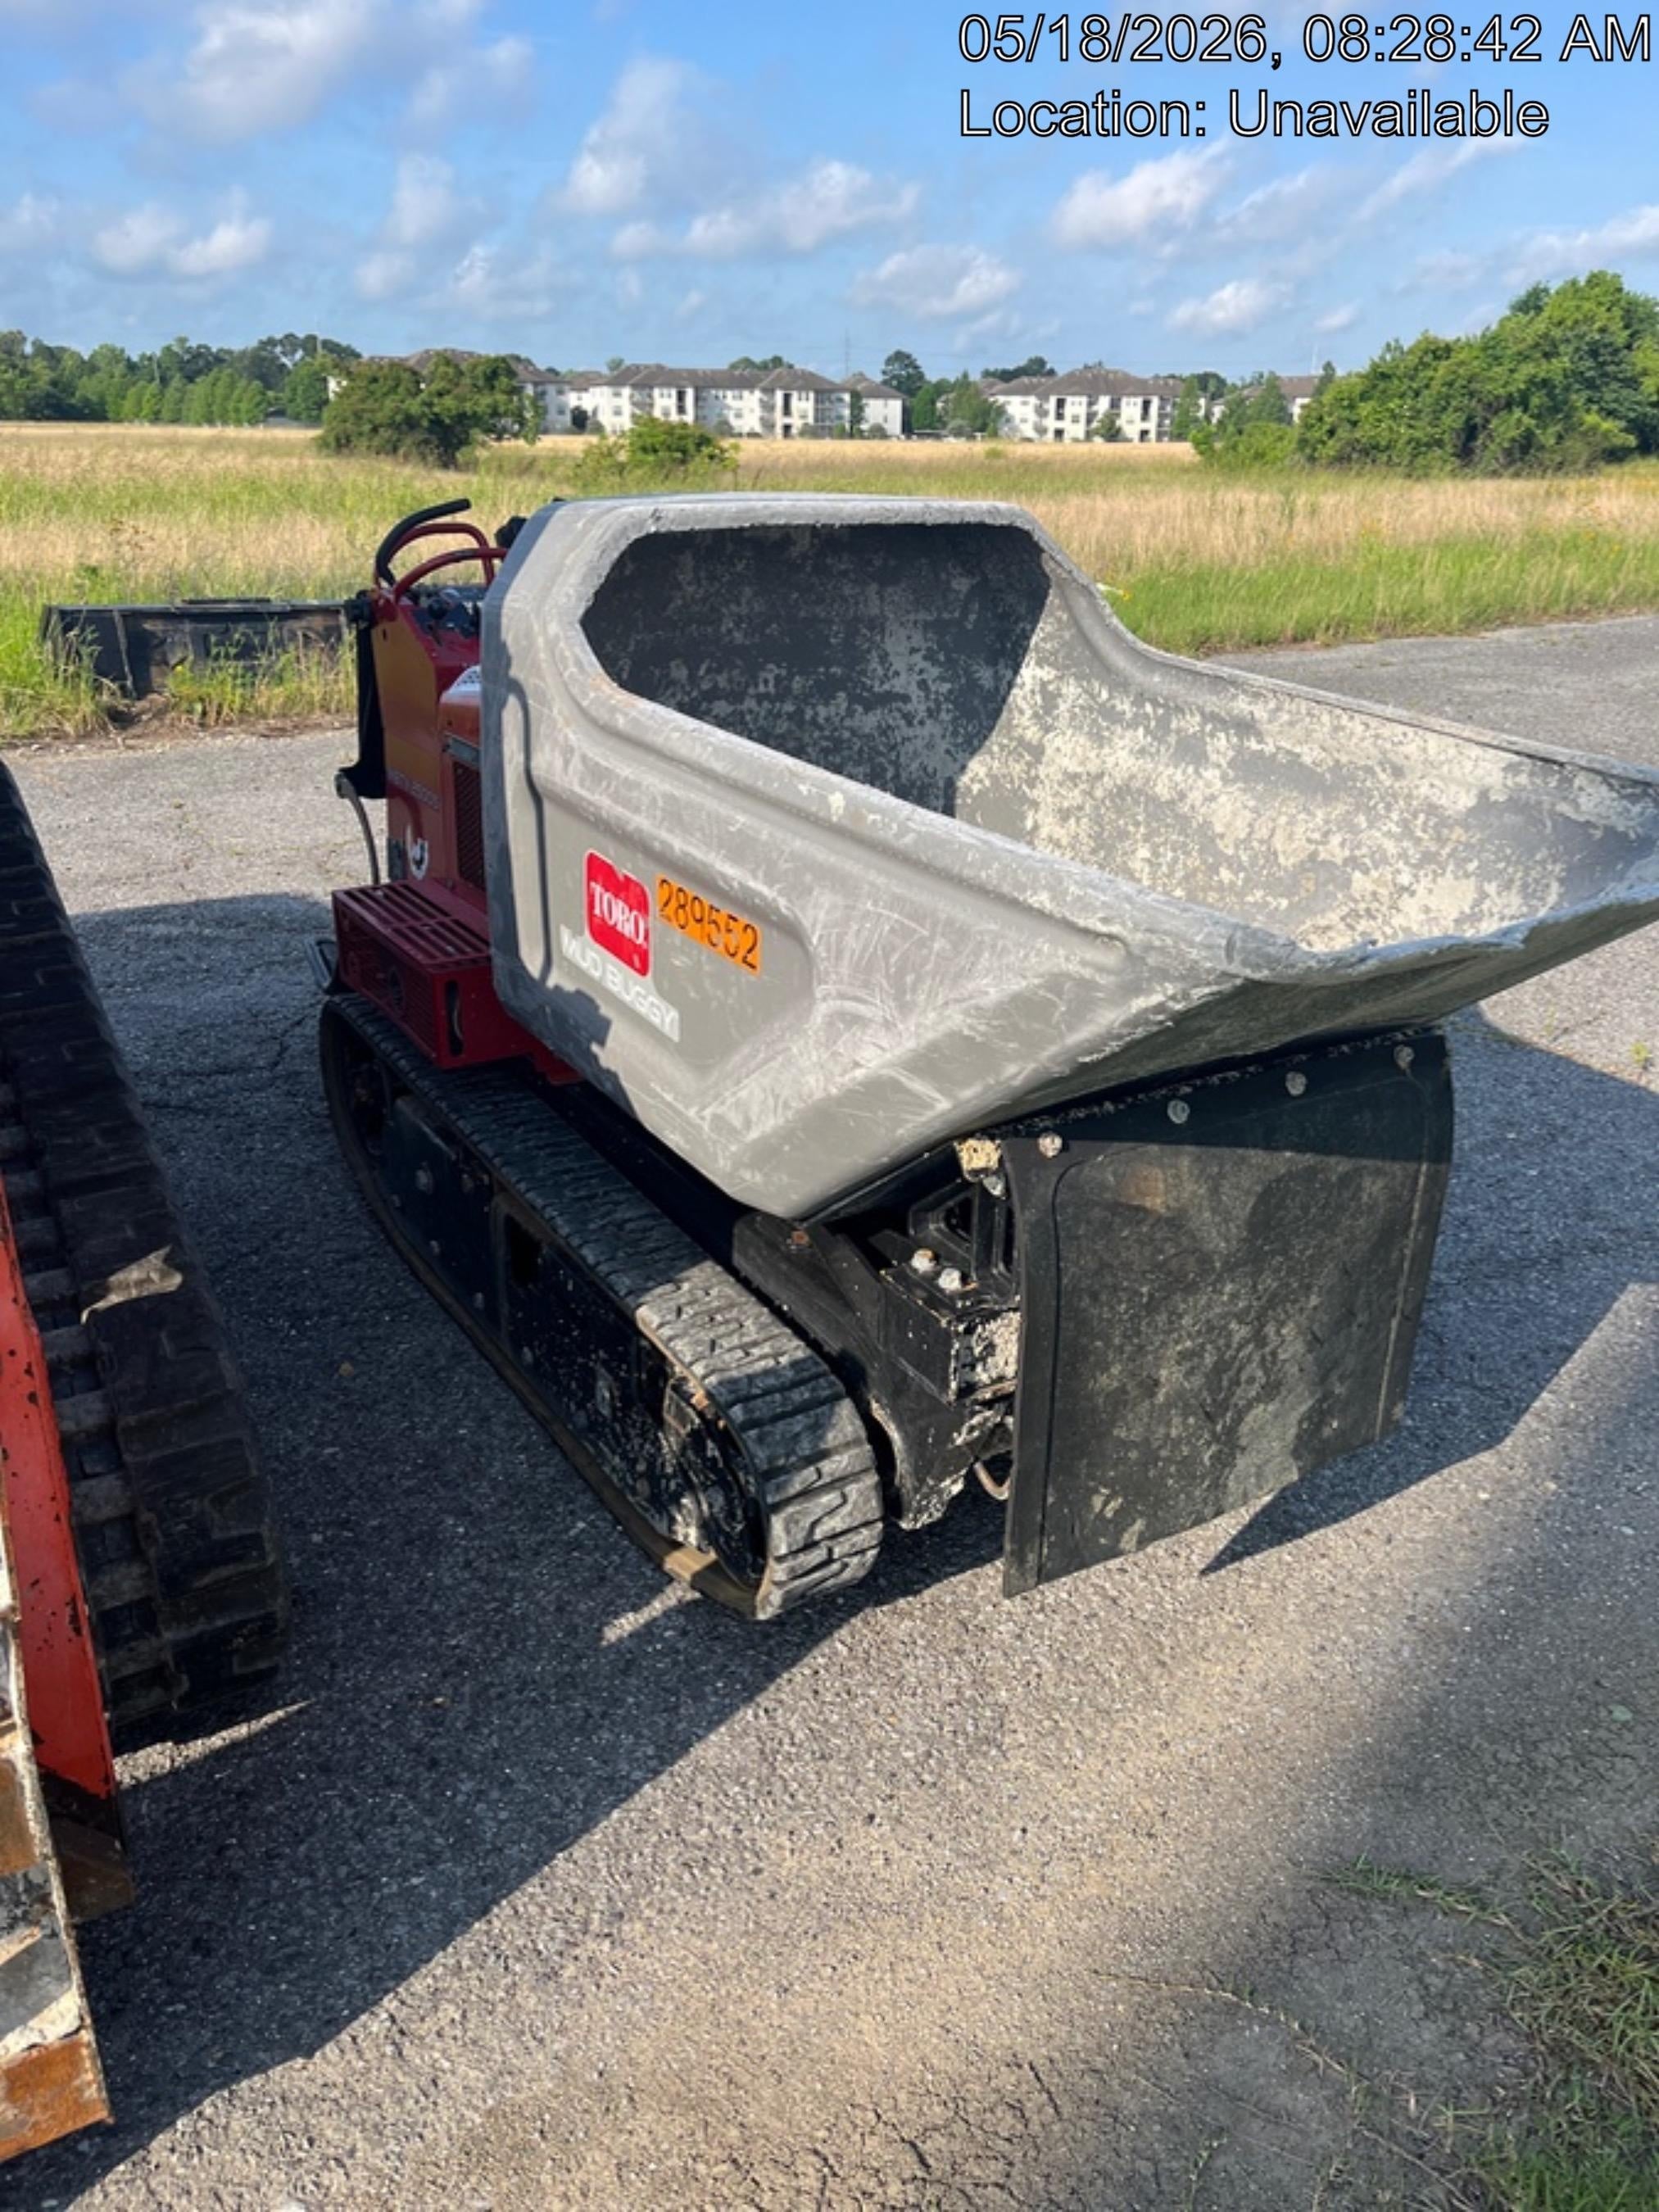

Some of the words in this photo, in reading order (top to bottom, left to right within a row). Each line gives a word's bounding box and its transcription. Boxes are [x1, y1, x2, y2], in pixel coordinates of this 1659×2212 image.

[589, 881, 646, 945] TORO
[657, 877, 759, 971] 289552
[604, 962, 679, 1042] BUGGY
